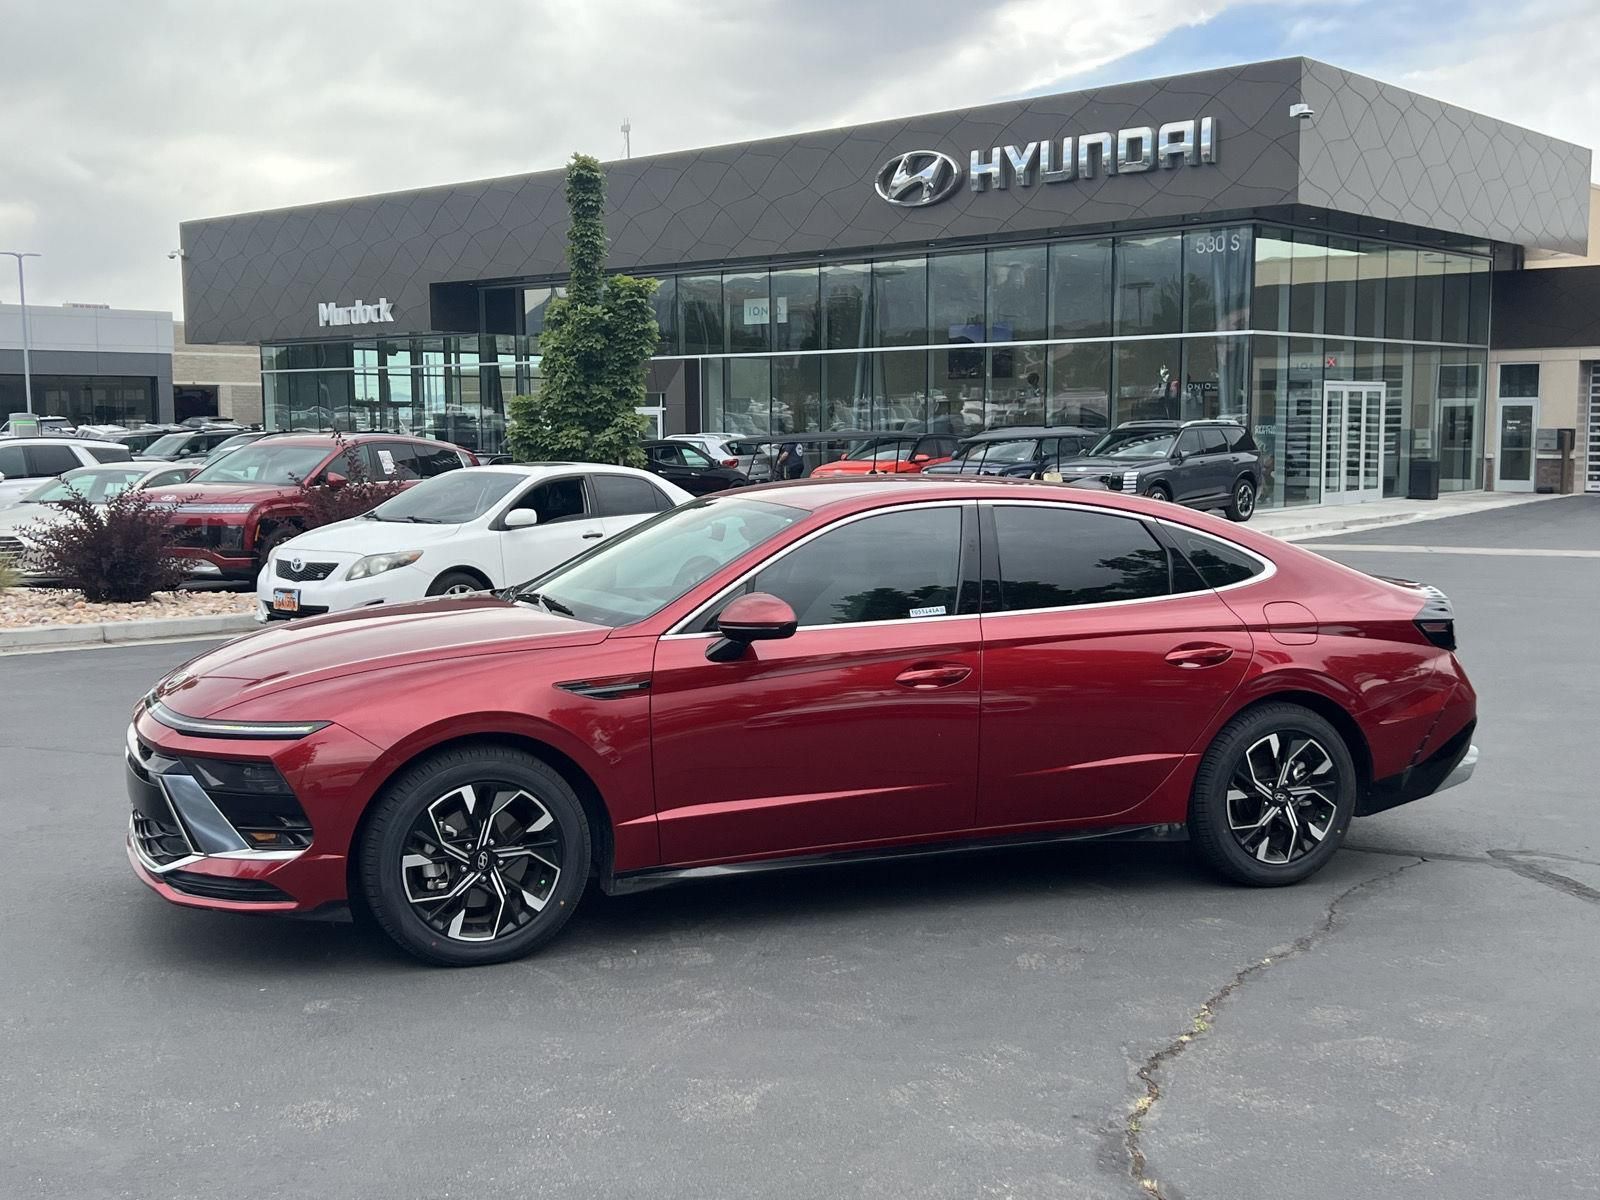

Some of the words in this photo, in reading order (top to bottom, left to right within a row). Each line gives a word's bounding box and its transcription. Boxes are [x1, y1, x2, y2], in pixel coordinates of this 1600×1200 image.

[970, 116, 1217, 192] HYUNDAI
[1196, 235, 1225, 253] 530
[1231, 234, 1240, 251] S
[317, 297, 394, 327] Murdock
